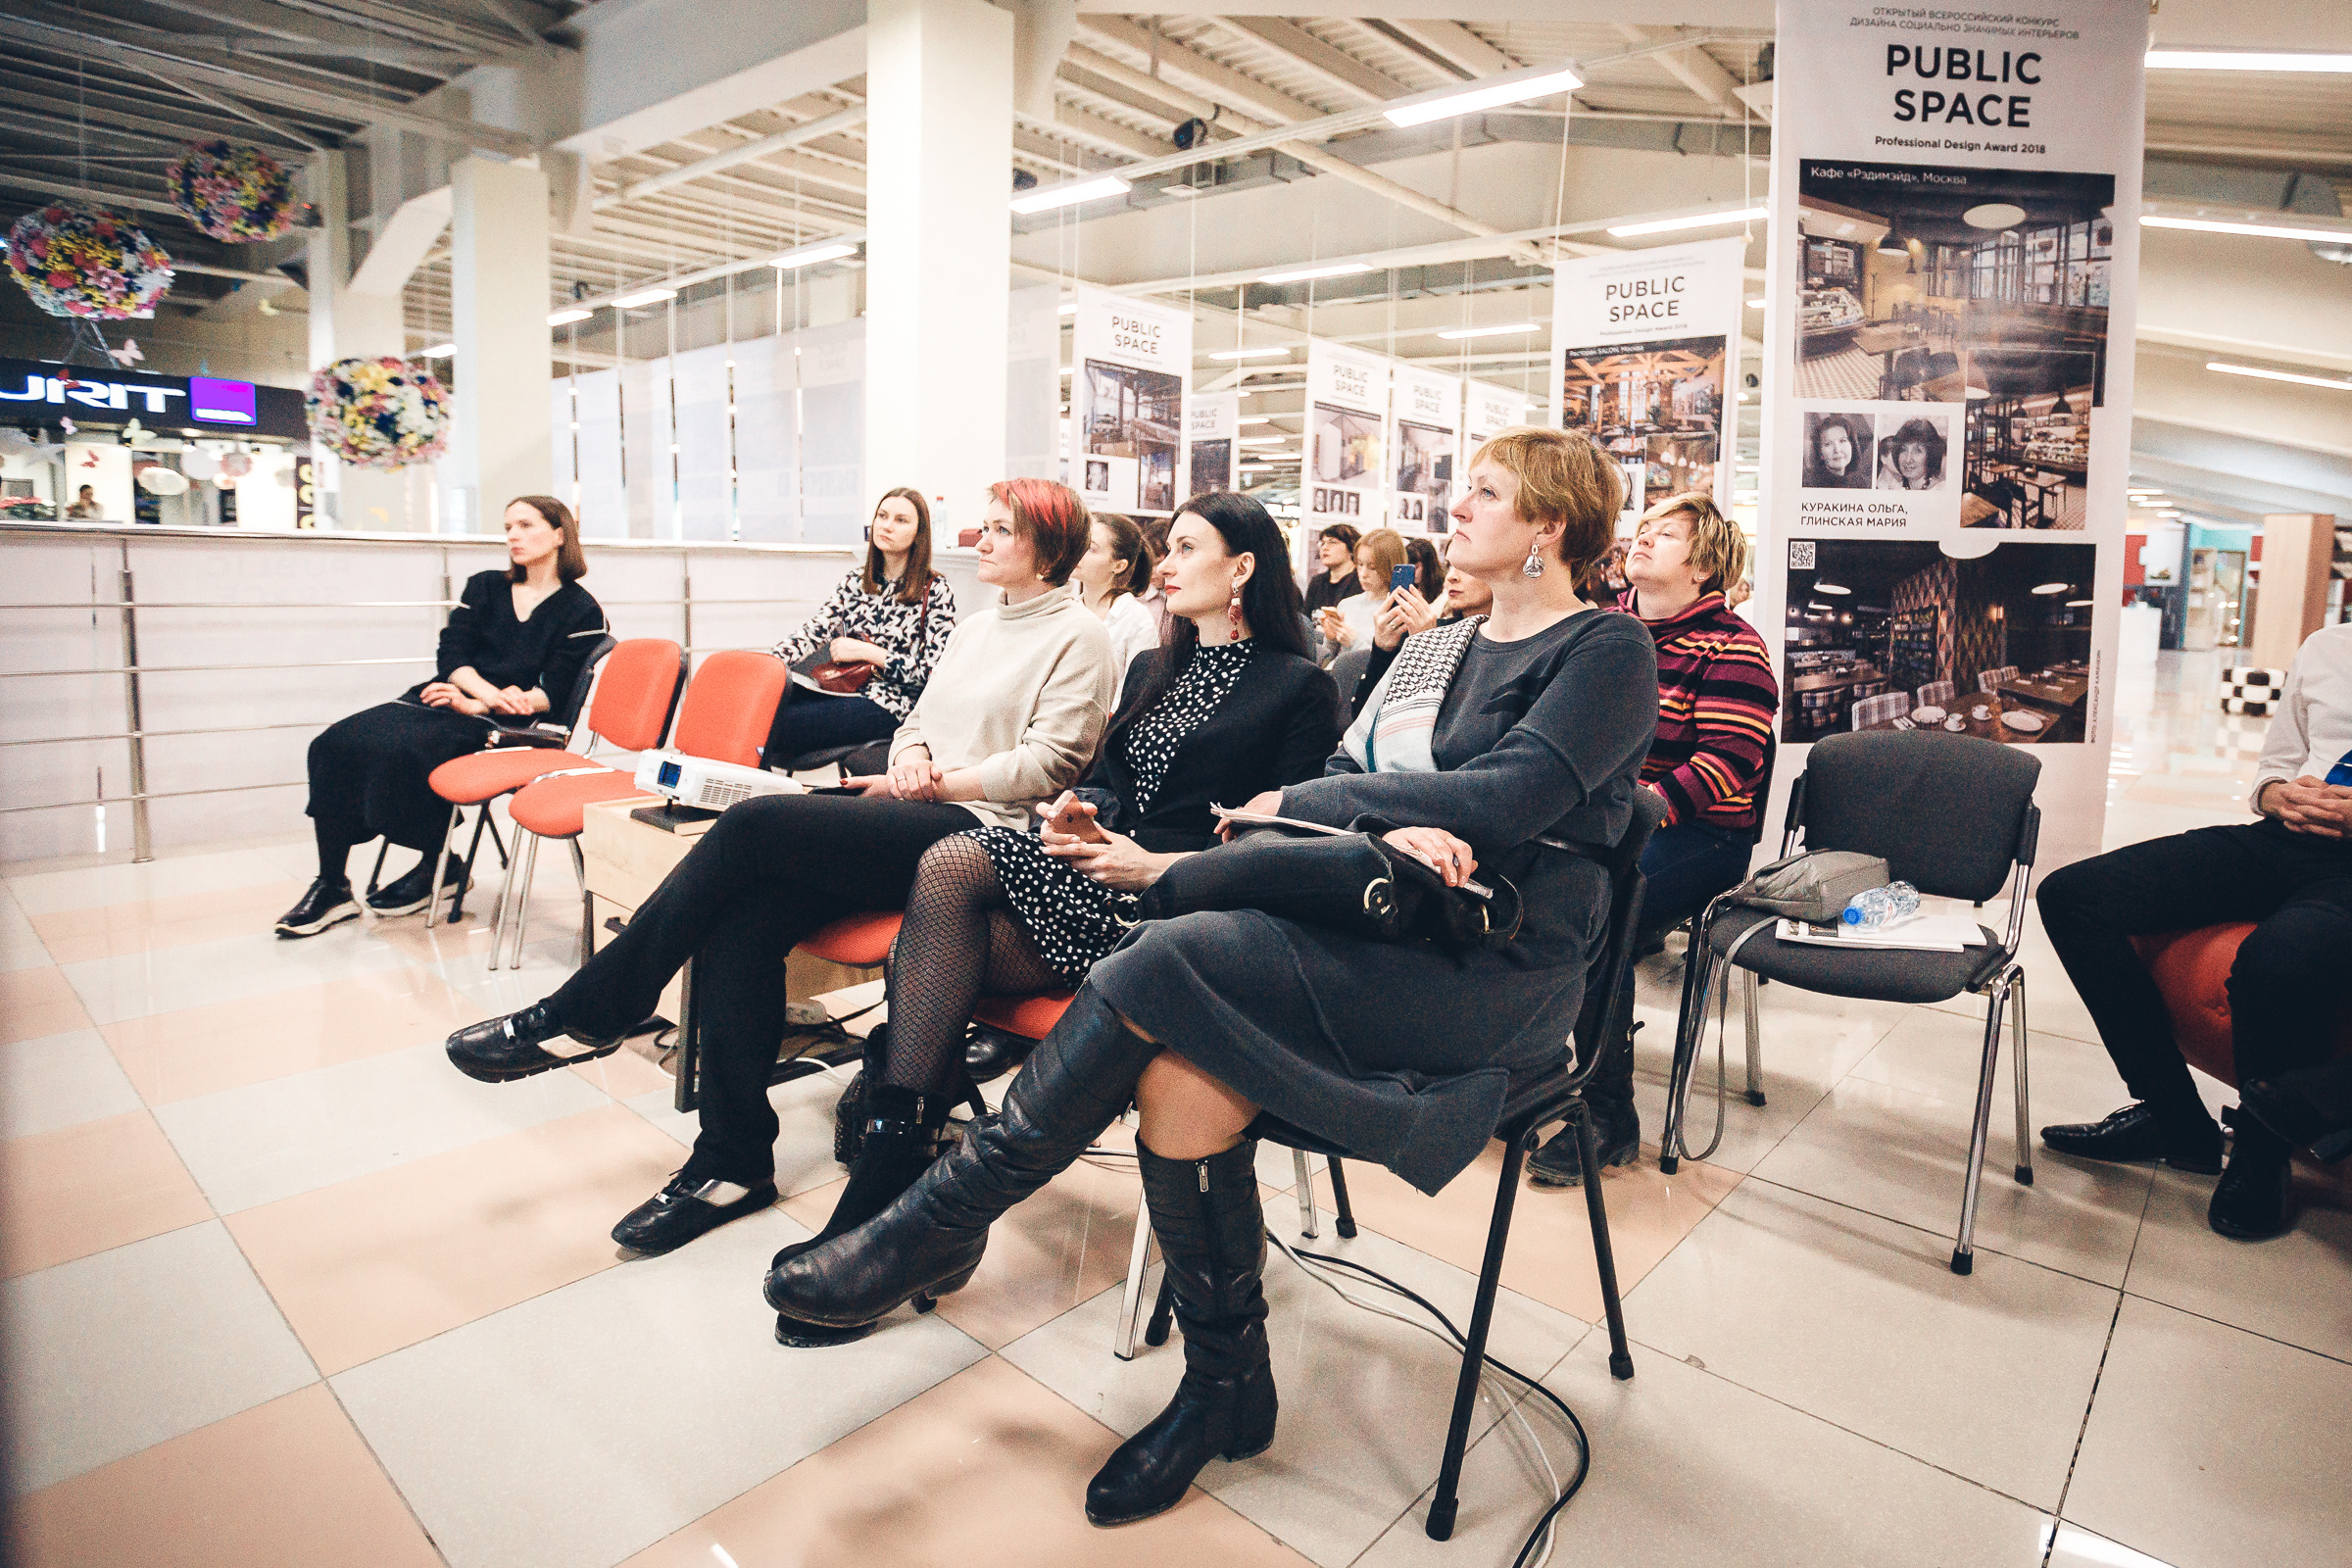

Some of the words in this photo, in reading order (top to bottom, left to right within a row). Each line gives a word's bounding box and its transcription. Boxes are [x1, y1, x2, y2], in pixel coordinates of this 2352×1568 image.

[1872, 7, 1927, 18] ОТКРЫТЫЙ
[1929, 10, 2013, 23] ВСЕРОССИЙСКИЙ
[2016, 16, 2060, 26] КОНКУРС
[1850, 17, 1897, 27] ДИЗАЙНА
[1899, 20, 1961, 32] СОЦИАЛЬНО
[1963, 24, 2015, 35] ЗНАЧИМЫХ
[2018, 28, 2080, 39] ИНТЕРЬЕРОВ
[1886, 44, 2041, 85] PUBLIC
[1893, 89, 2032, 127] SPACE
[1875, 135, 1941, 148] Professional
[1944, 139, 1982, 151] Design
[1984, 142, 2019, 153] Award
[2021, 143, 2046, 154] 2018
[1810, 167, 1844, 179] Кафе
[1923, 172, 1967, 185] Москва
[1605, 276, 1686, 301] PUBLIC
[1609, 301, 1680, 322] SPACE
[1111, 316, 1161, 339] PUBLIC
[1114, 334, 1158, 355] SPACE
[1334, 365, 1368, 383] PUBLIC
[1335, 380, 1365, 397] SPACE
[1801, 502, 1864, 513] КУРАКИНА
[1868, 504, 1908, 514] ОЛЬГА,
[1800, 515, 1863, 527] ГЛИНСКАЯ
[1866, 517, 1907, 527] МАРИЯ
